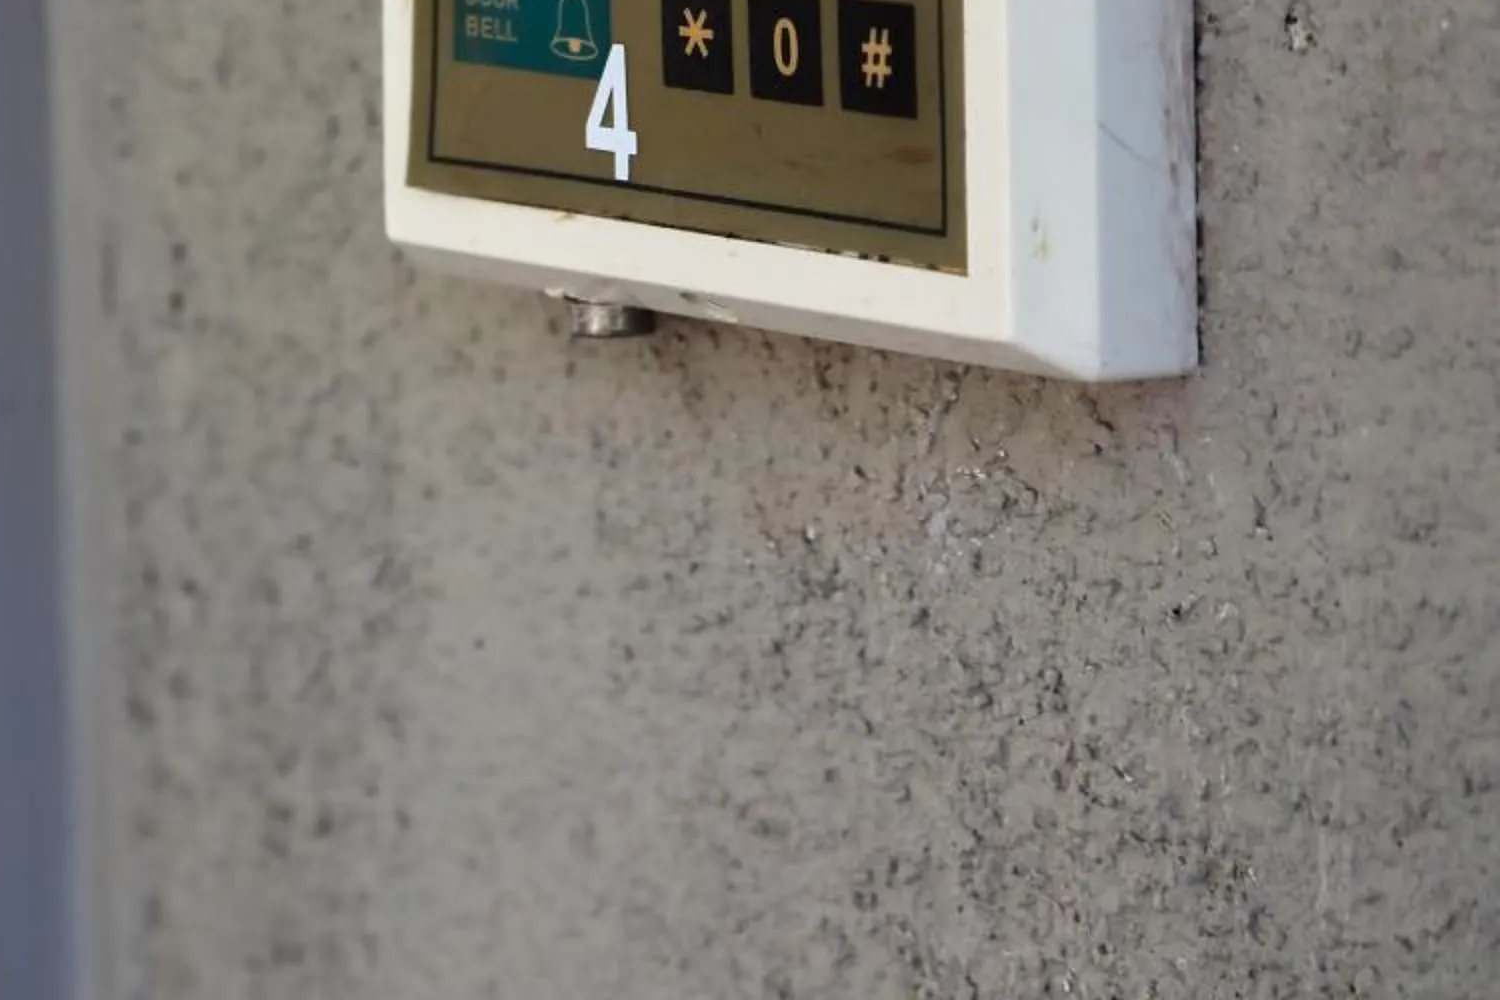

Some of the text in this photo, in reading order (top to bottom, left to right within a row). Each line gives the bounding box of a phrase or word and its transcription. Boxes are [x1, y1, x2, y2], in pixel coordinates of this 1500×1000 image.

[465, 14, 519, 43] BELL
[773, 17, 799, 78] 0
[861, 26, 893, 89] #
[585, 43, 638, 181] 4
